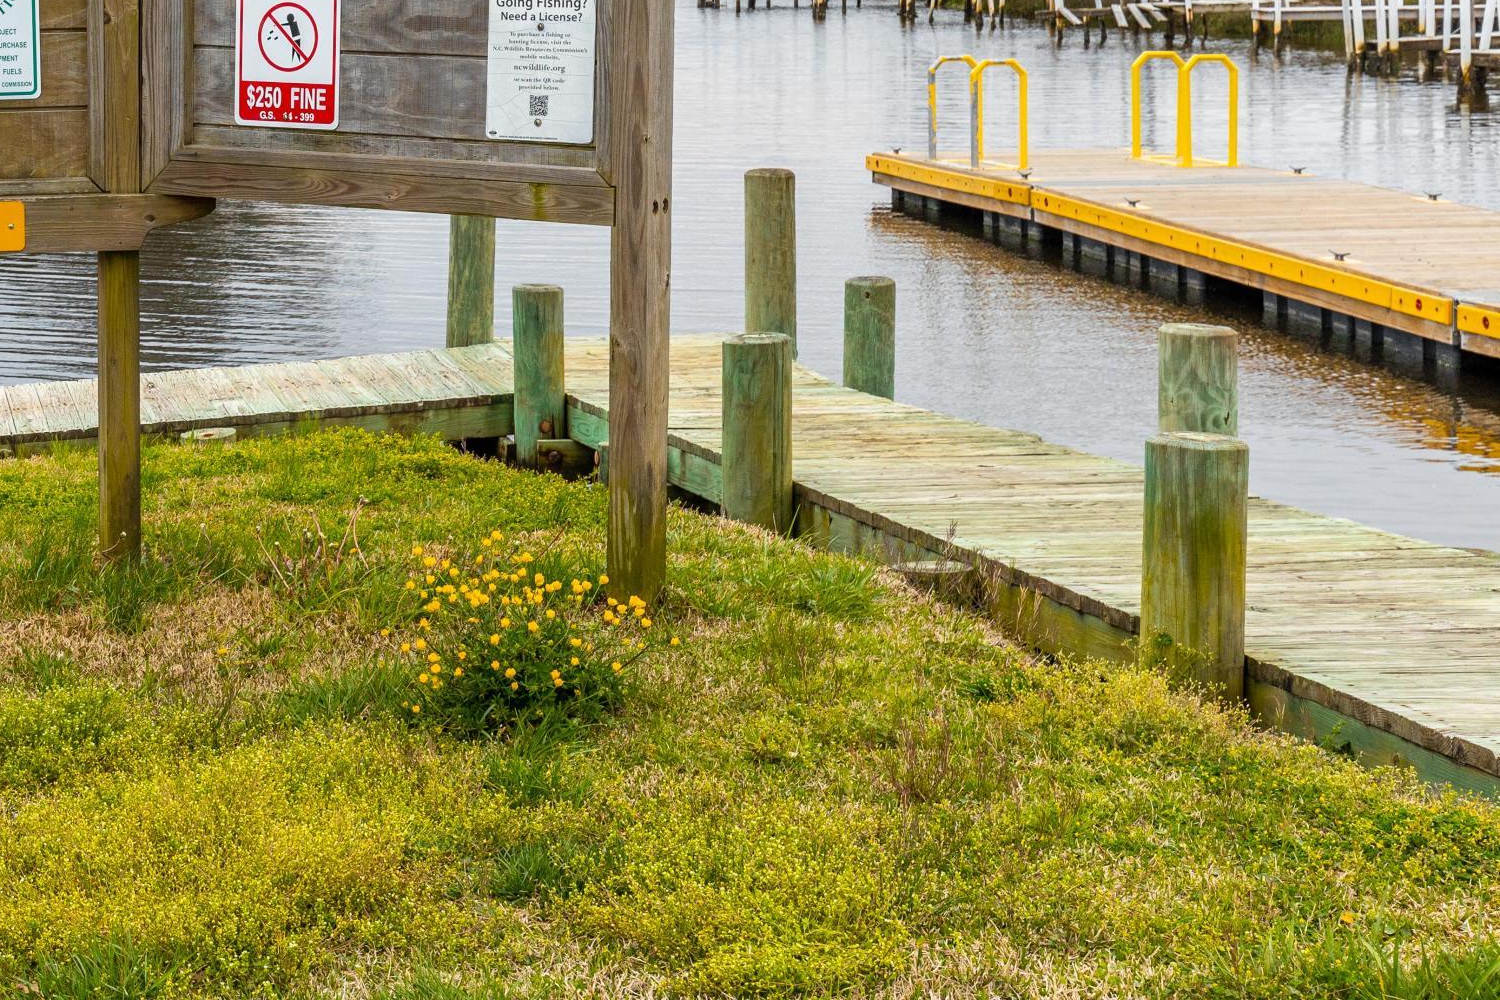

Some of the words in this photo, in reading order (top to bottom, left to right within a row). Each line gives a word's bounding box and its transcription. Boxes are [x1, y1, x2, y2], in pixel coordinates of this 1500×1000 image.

[501, 12, 527, 21] Need
[540, 12, 582, 22] License?
[514, 64, 566, 73] ncwildlife.org
[247, 84, 282, 109] $250
[291, 88, 326, 110] FINE
[260, 111, 276, 120] G.S.
[283, 111, 293, 121] 4
[300, 113, 314, 122] 399
